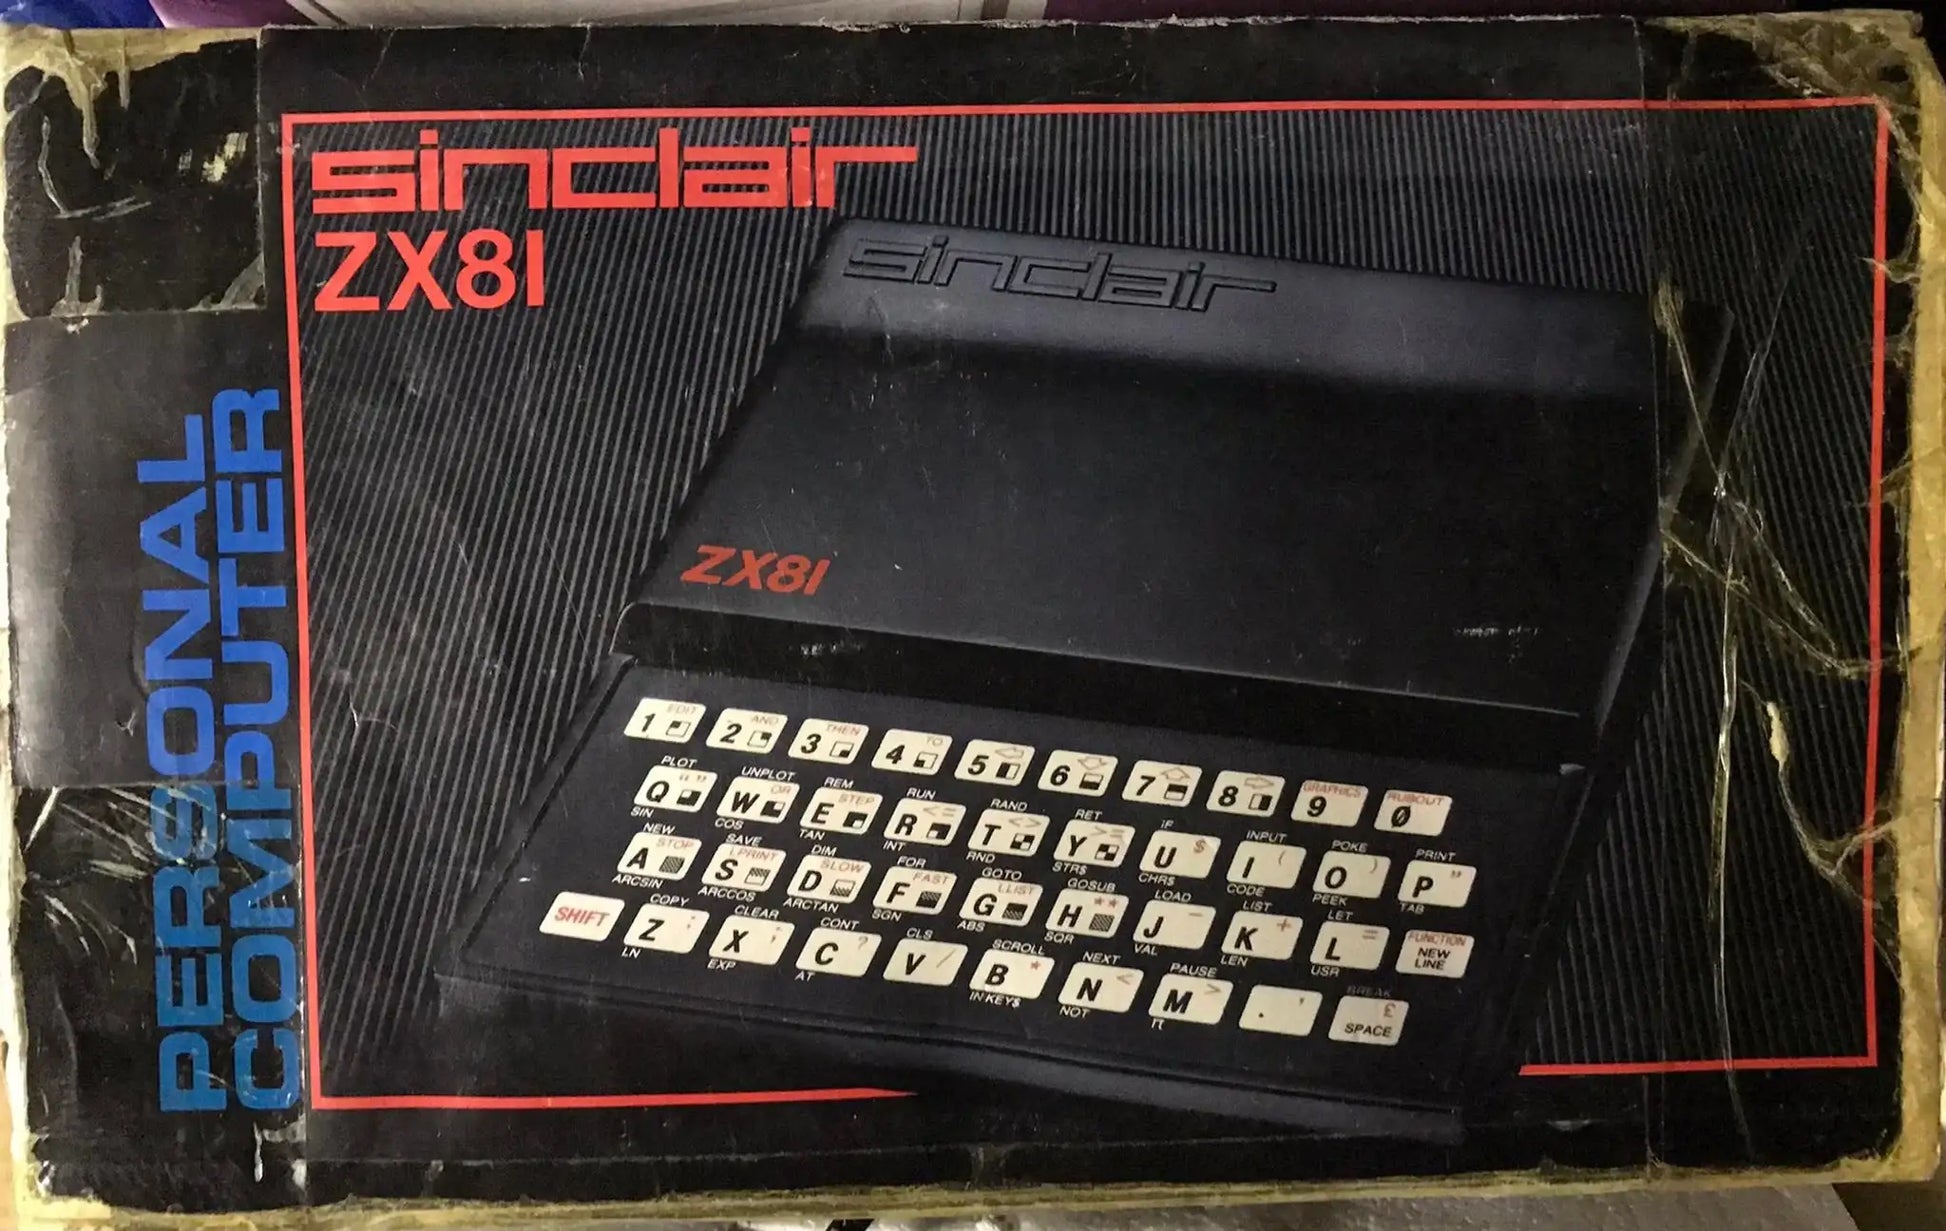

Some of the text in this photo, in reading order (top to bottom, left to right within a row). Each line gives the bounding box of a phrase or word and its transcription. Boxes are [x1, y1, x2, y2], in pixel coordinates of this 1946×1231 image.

[311, 126, 917, 214] sinclair
[314, 228, 545, 312] ZX81
[843, 234, 1277, 312] sinclair
[680, 544, 831, 596] ZX81
[666, 704, 698, 714] EDIT
[641, 713, 655, 732] 1
[751, 715, 778, 725] AND
[720, 723, 742, 744] 2
[825, 724, 861, 736] THEN
[800, 733, 822, 754] 3
[927, 737, 943, 746] TO
[212, 388, 301, 1112] COMPUTER
[885, 745, 905, 765] 4
[137, 414, 227, 1112] PERSONAL
[661, 755, 697, 768] PLOT
[967, 755, 989, 775] 5
[741, 767, 796, 781] UNPLOT
[1050, 765, 1070, 785] 6
[770, 785, 791, 795] OR
[824, 777, 854, 789] REM
[1136, 775, 1155, 796] 7
[1303, 782, 1361, 798] GRAPHICS
[646, 781, 669, 803] Q
[839, 793, 875, 805] STEP
[907, 788, 936, 799] RUN
[1218, 786, 1238, 806] 8
[1388, 792, 1444, 806] RUBOUT
[731, 791, 760, 814] W
[991, 799, 1028, 812] RAND
[1307, 796, 1326, 817] 9
[630, 807, 653, 818] SIN
[811, 803, 834, 824] E
[1075, 809, 1102, 820] RET
[643, 823, 676, 835] NEW
[715, 818, 743, 830] COS
[895, 813, 918, 836] R
[725, 834, 762, 847] SAVE
[799, 830, 825, 841] TAN
[983, 825, 1002, 846] T
[1247, 830, 1287, 843] INPUT
[656, 837, 694, 849] STOP
[811, 844, 837, 856] DIM
[883, 841, 906, 851] INT
[1068, 835, 1088, 857] Y
[1332, 840, 1368, 852] POKE
[627, 848, 650, 869] A
[729, 848, 779, 862] LPRINT
[897, 856, 927, 868] FOR
[966, 851, 995, 864] RND
[1154, 846, 1178, 869] U
[1415, 850, 1456, 862] PRINT
[715, 859, 739, 881] S
[820, 859, 864, 873] SLOW
[1242, 857, 1255, 879] I
[612, 874, 663, 889] ARCSIN
[798, 870, 823, 892] D
[913, 872, 949, 885] FAST
[1325, 866, 1347, 889] O
[1067, 878, 1117, 892] GOSUB
[1227, 884, 1265, 897] CODE
[1412, 876, 1434, 898] P
[650, 893, 690, 907] COPY
[697, 885, 756, 902] ARCCOS
[887, 882, 910, 904] F
[1154, 890, 1192, 902] LOAD
[1312, 894, 1348, 906] PEEK
[784, 898, 839, 913] ARCTAN
[973, 893, 998, 916] G
[1243, 900, 1273, 912] LIST
[1400, 903, 1425, 914] TAB
[554, 907, 611, 927] SHIFT
[734, 905, 779, 920] CLEAR
[871, 909, 902, 922] SGN
[1057, 904, 1083, 928] H
[1328, 910, 1353, 921] LET
[639, 919, 665, 941] Z
[820, 917, 859, 930] CONT
[957, 920, 985, 932] ABS
[1143, 916, 1164, 939] J
[907, 928, 933, 939] CLS
[1044, 932, 1075, 944] SQR
[1234, 927, 1259, 950] K
[1408, 932, 1466, 946] FUNCTION
[723, 930, 749, 952] X
[858, 937, 869, 950] ?
[992, 939, 1046, 955] SCROLL
[621, 947, 641, 959] LN
[815, 942, 839, 965] C
[1134, 944, 1158, 956] VAL
[1325, 937, 1341, 961] L
[1418, 948, 1451, 959] NEW
[707, 959, 736, 970] EXP
[905, 953, 926, 975] V
[1083, 951, 1121, 965] NEXT
[1220, 955, 1248, 967] LEN
[1415, 959, 1445, 970] LINE
[795, 972, 815, 982] AT
[985, 964, 1009, 986] B
[1170, 963, 1217, 978] PAUSE
[1311, 965, 1340, 977] USR
[1077, 978, 1102, 1002] N
[1347, 985, 1392, 998] BREAK
[1163, 989, 1193, 1014] M
[1059, 1006, 1090, 1018] NOT
[1344, 1023, 1392, 1038] SPACE
